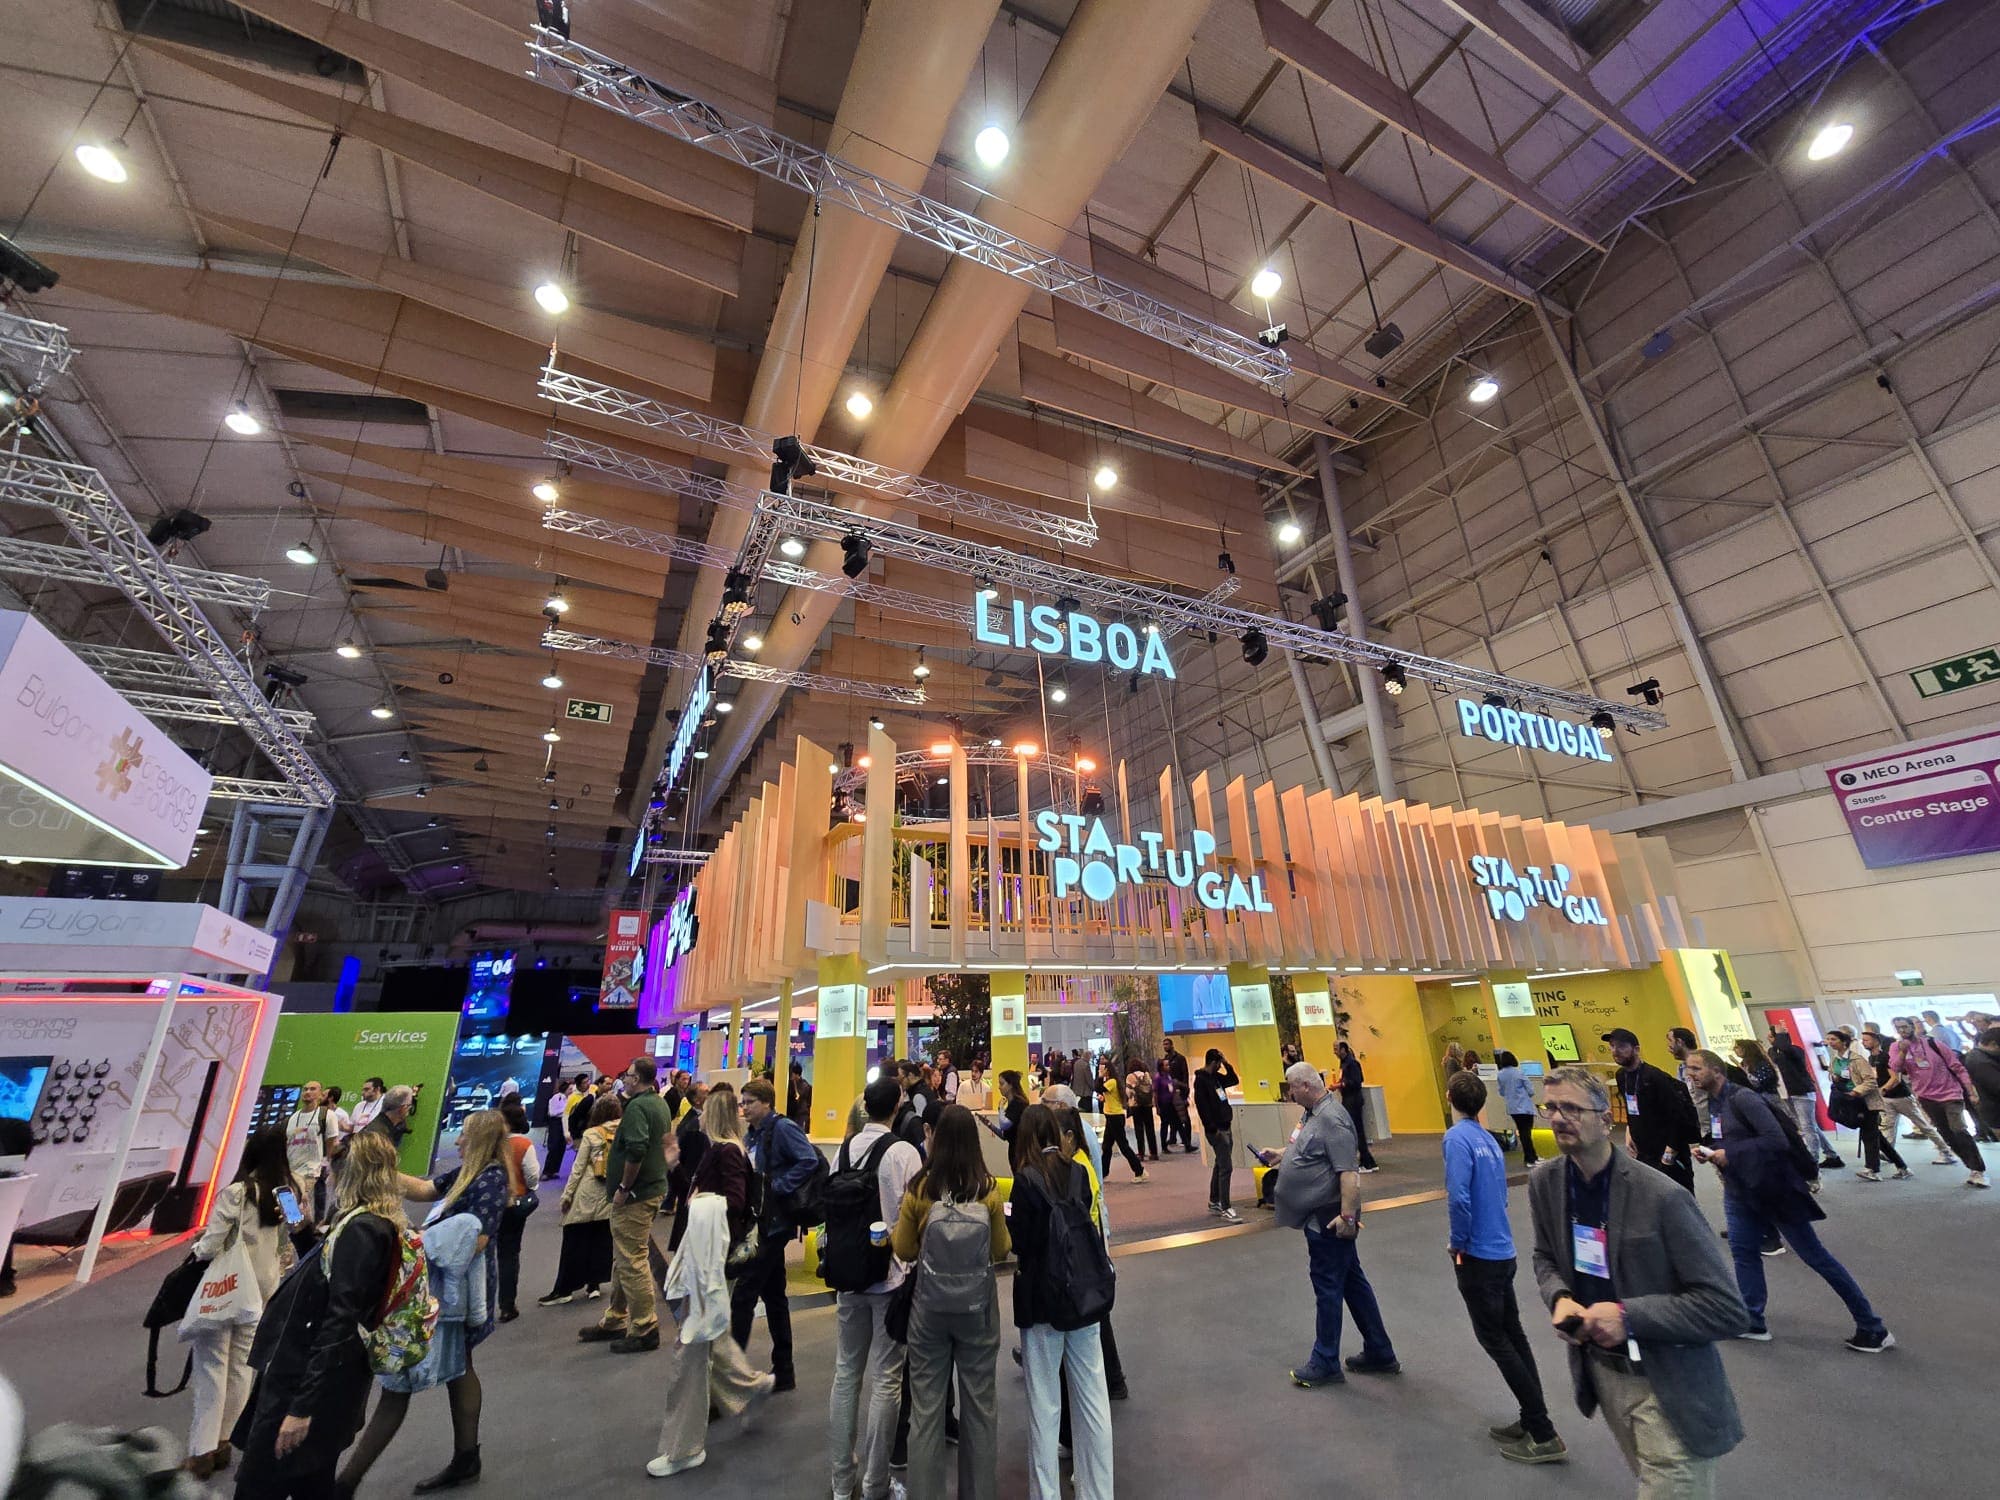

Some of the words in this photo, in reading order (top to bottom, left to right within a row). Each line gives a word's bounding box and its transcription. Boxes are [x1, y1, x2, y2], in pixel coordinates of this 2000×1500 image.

[975, 591, 1176, 679] LISBOA
[1458, 699, 1613, 762] PORTUGAL
[1863, 765, 1900, 782] MEO
[1905, 753, 1956, 772] Arena
[1852, 793, 1886, 805] Stages
[1860, 807, 1925, 827] Centre
[1926, 795, 1989, 816] Stage
[492, 960, 512, 975] 04
[1532, 991, 1567, 1003] TING
[1535, 1006, 1560, 1018] INT
[353, 1030, 428, 1043] iServices
